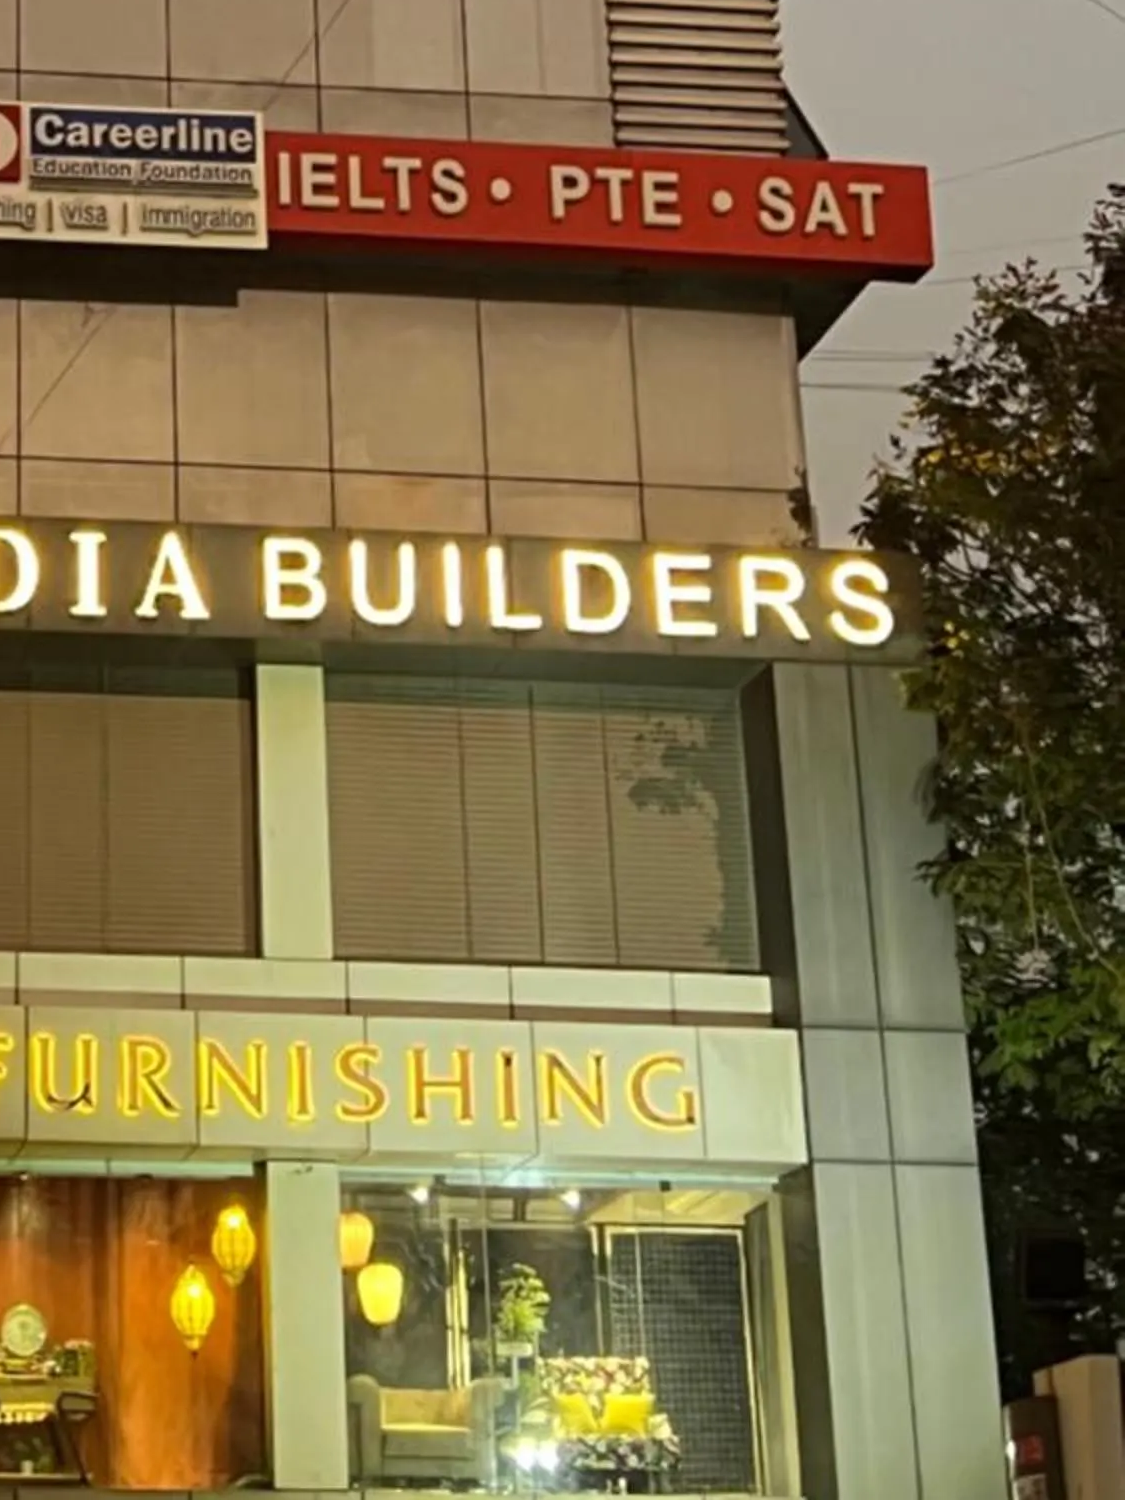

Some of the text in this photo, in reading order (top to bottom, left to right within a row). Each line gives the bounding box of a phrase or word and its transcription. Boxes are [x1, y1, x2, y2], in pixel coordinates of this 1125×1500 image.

[33, 112, 254, 154] Careerline
[32, 157, 253, 183] Education Foundation
[62, 200, 108, 224] visa
[141, 204, 257, 231] immigration
[277, 151, 884, 238] IELTS PTE SAT
[262, 536, 895, 646] BUILDERS
